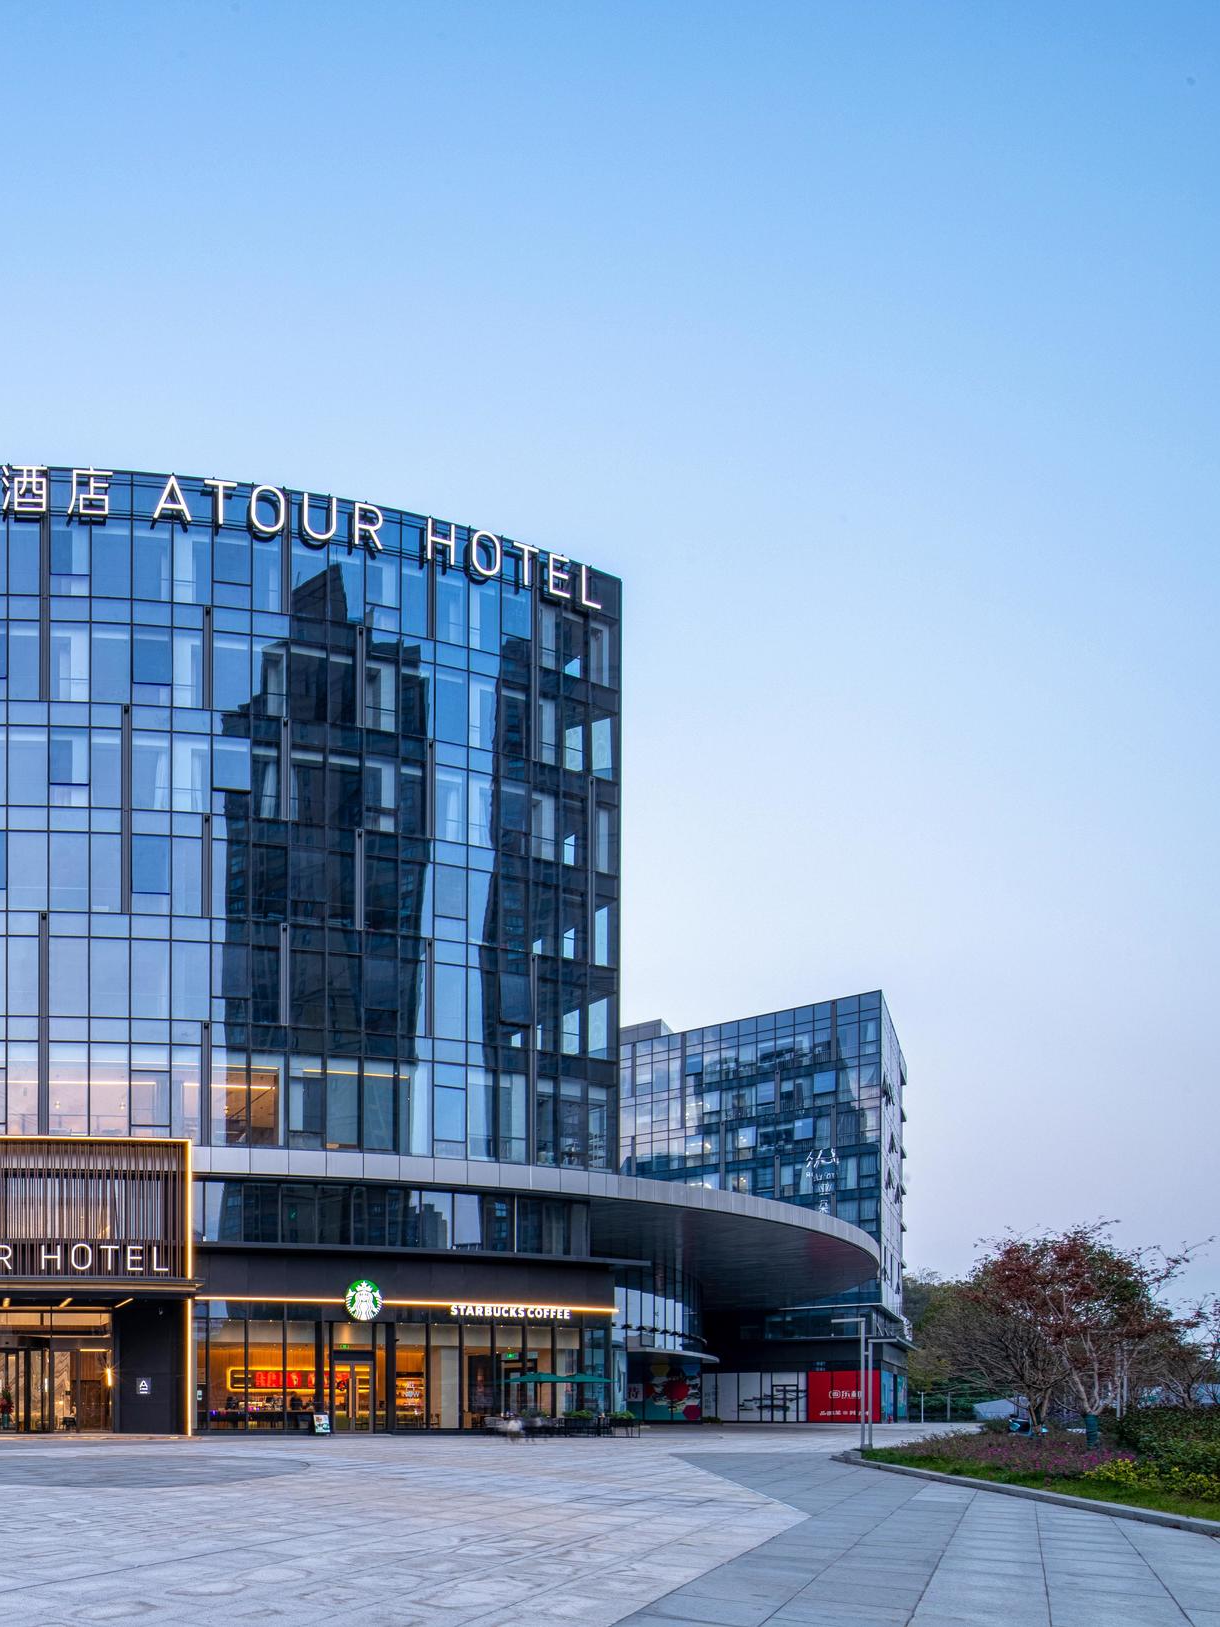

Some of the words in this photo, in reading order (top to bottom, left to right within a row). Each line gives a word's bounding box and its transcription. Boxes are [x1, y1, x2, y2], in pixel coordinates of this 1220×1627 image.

[153, 475, 384, 550] ATOUR
[426, 517, 602, 610] HOTEL
[41, 1243, 169, 1272] HOTEL
[450, 1304, 525, 1318] STARBUCKS
[526, 1307, 571, 1320] COFFEE
